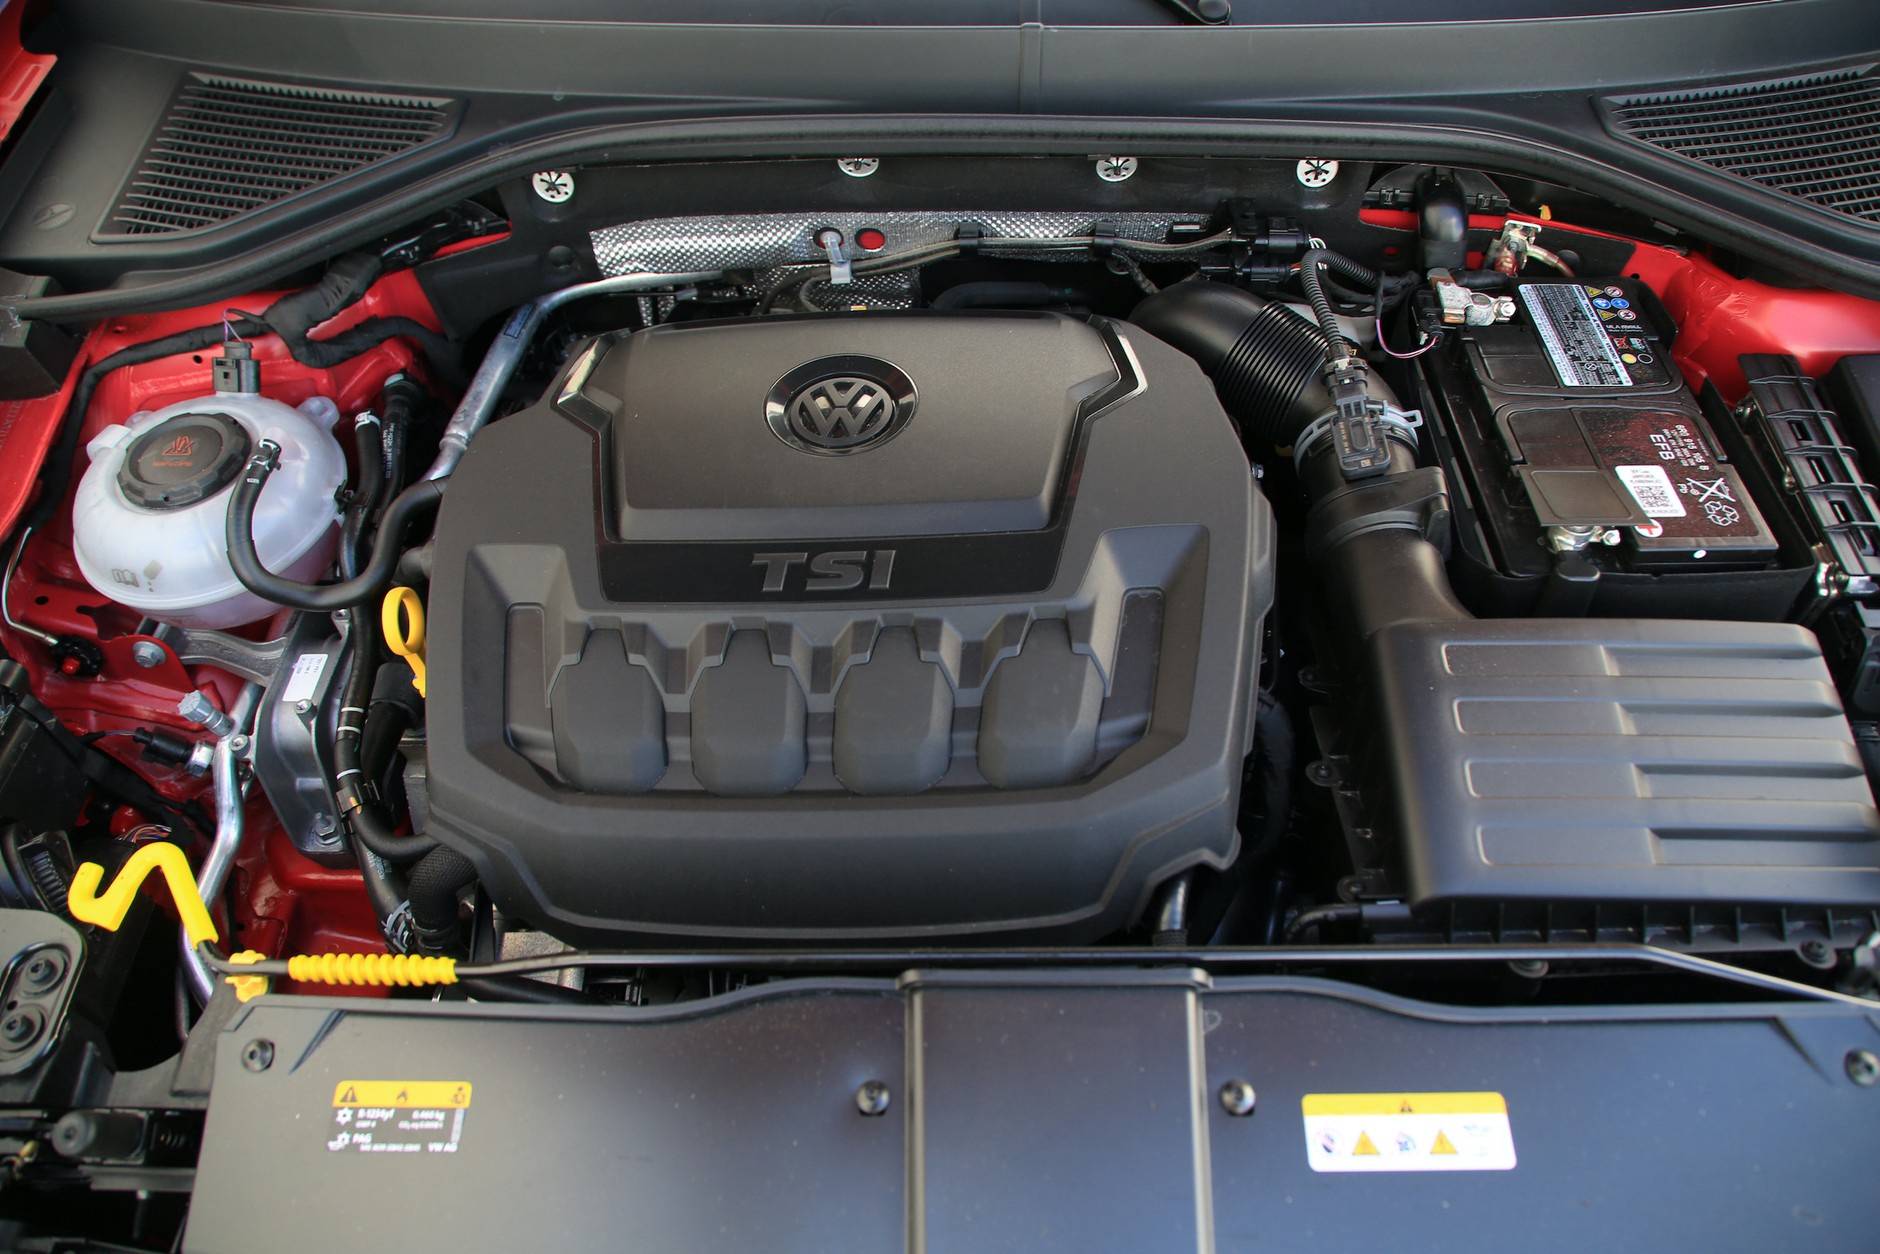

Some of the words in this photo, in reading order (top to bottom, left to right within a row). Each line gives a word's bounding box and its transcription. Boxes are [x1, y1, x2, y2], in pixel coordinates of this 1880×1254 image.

[790, 376, 893, 448] VW
[1650, 434, 1676, 460] EFB
[1676, 483, 1689, 494] Pb
[752, 550, 896, 592] TSI
[352, 1133, 372, 1144] PAG
